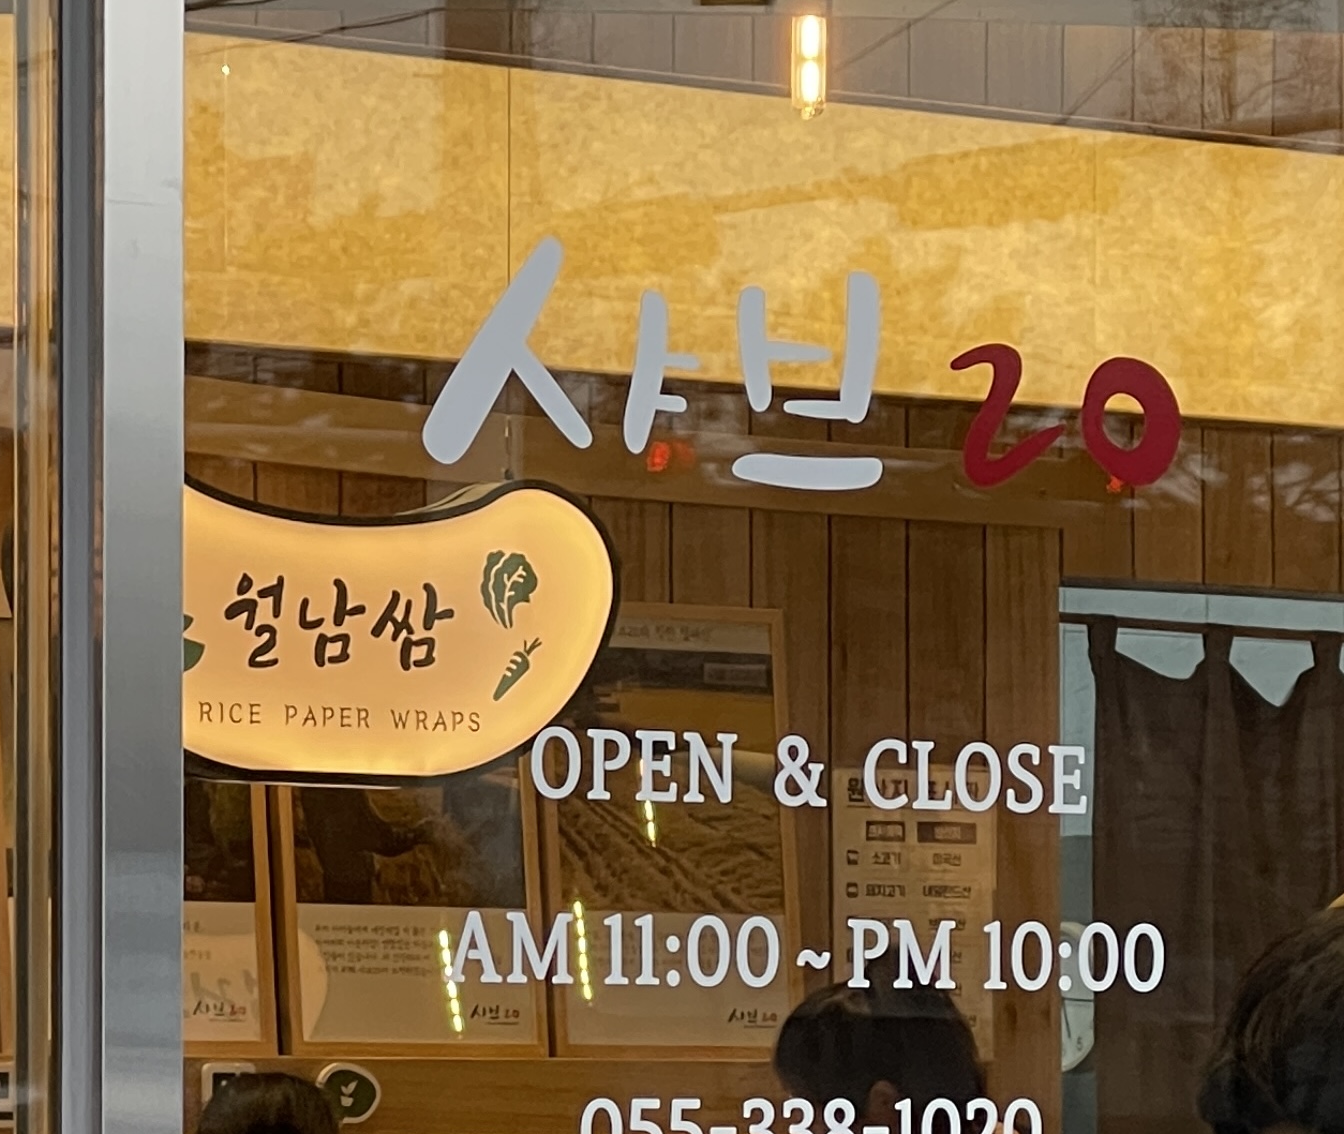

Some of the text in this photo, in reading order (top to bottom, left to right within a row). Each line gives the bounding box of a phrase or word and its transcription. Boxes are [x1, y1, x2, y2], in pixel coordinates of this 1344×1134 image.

[422, 236, 1181, 491] 샤브 20
[224, 572, 455, 671] 월남쌈
[199, 702, 483, 733] RICE PAPER WRAPS
[531, 726, 1088, 815] OPEN & CLOSE
[451, 911, 574, 984] AM
[603, 912, 780, 989] 11:00
[846, 918, 957, 991] PM
[982, 920, 1166, 994] 10:00
